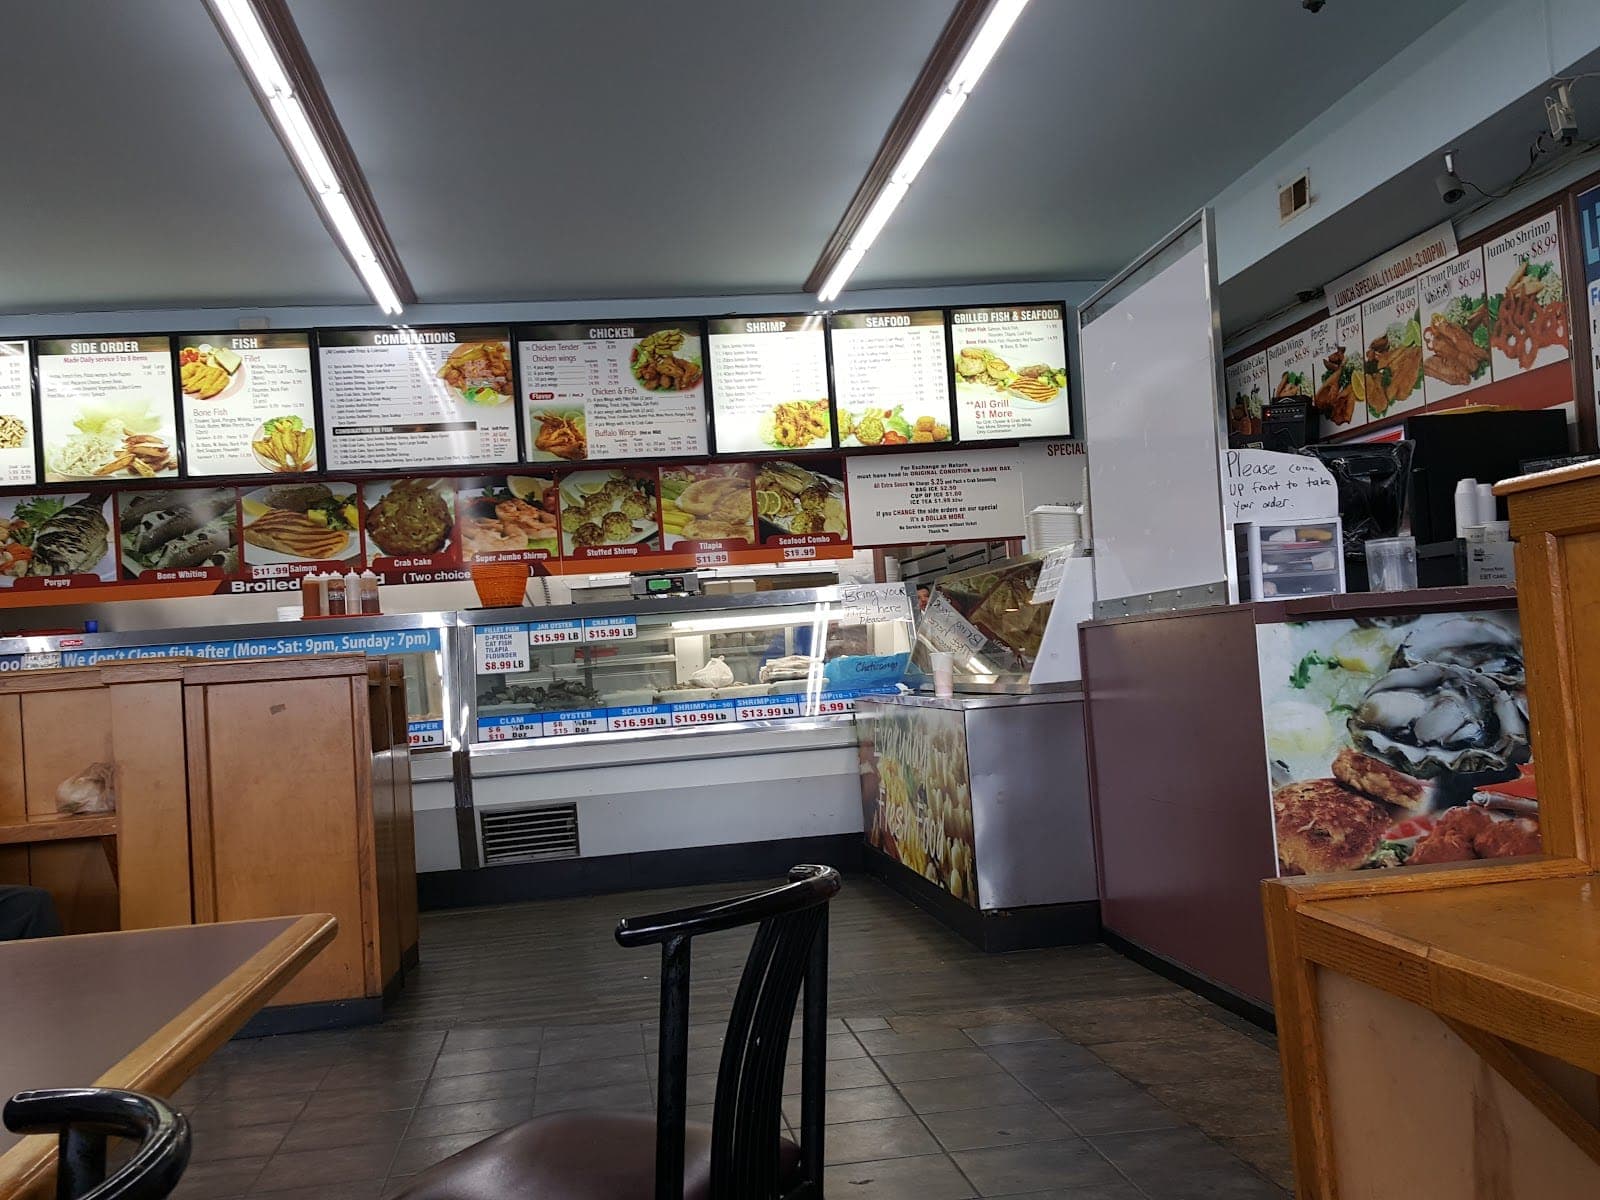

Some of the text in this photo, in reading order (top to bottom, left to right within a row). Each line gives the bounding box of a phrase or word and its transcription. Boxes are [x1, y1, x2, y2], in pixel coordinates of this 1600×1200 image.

[1487, 222, 1550, 260] Jumbo Shrimp
[1531, 234, 1557, 258] $8.99
[1447, 259, 1470, 281] Platter
[1458, 268, 1481, 290] $6.99
[1334, 272, 1382, 308] LUNCH SPECIAL
[1395, 285, 1416, 303] Platter
[1395, 297, 1416, 318] $9.99
[866, 316, 910, 327] SEAFOOD
[954, 309, 1059, 324] GRILLED FISH & SEAFOOD
[1336, 313, 1356, 329] Platter
[746, 321, 786, 333] SHRIMP
[374, 332, 456, 345] COMBINATIONS
[589, 328, 634, 338] CHICKEN
[71, 341, 139, 354] SIDE ORDER
[232, 338, 258, 349] FISH
[558, 343, 579, 351] Tender
[559, 355, 577, 363] wings
[592, 387, 616, 396] Chicken
[990, 400, 1009, 408] Grill
[975, 410, 1013, 419] $1 More
[595, 429, 617, 437] Buffalo
[618, 429, 637, 437] Wings
[1048, 443, 1086, 456] SPECIAL
[1226, 450, 1277, 478] Please
[1286, 480, 1298, 489] to
[978, 504, 998, 512] special
[698, 542, 722, 550] Tilapia
[778, 537, 806, 545] Seafood
[393, 558, 432, 567] Crab Cake
[475, 555, 496, 563] Super
[498, 553, 521, 561] Jumbo
[696, 555, 727, 564] $11.99
[253, 567, 288, 576] $11.99
[290, 564, 318, 573] Salmon
[157, 569, 208, 580] Bone Whiting
[231, 579, 300, 593] Broiled
[534, 632, 579, 643] $15.99 LB
[589, 629, 634, 639] $15.99 LB
[63, 653, 86, 667] We
[167, 645, 193, 657] fish
[196, 643, 231, 658] after
[233, 641, 302, 658] (Mon~Sat:
[305, 638, 338, 653] 9pm,
[342, 634, 395, 650] Sunday:
[397, 631, 431, 647] 7pm)
[485, 660, 524, 670] $8.99 LB
[560, 712, 592, 720] OYSTER
[621, 706, 658, 716] SCALLOP
[742, 707, 781, 718] $13.99
[500, 717, 524, 725] CLAM
[613, 717, 666, 729] $16.99 Lb
[675, 713, 727, 724] $10.99 Lb
[421, 735, 434, 743] Lb
